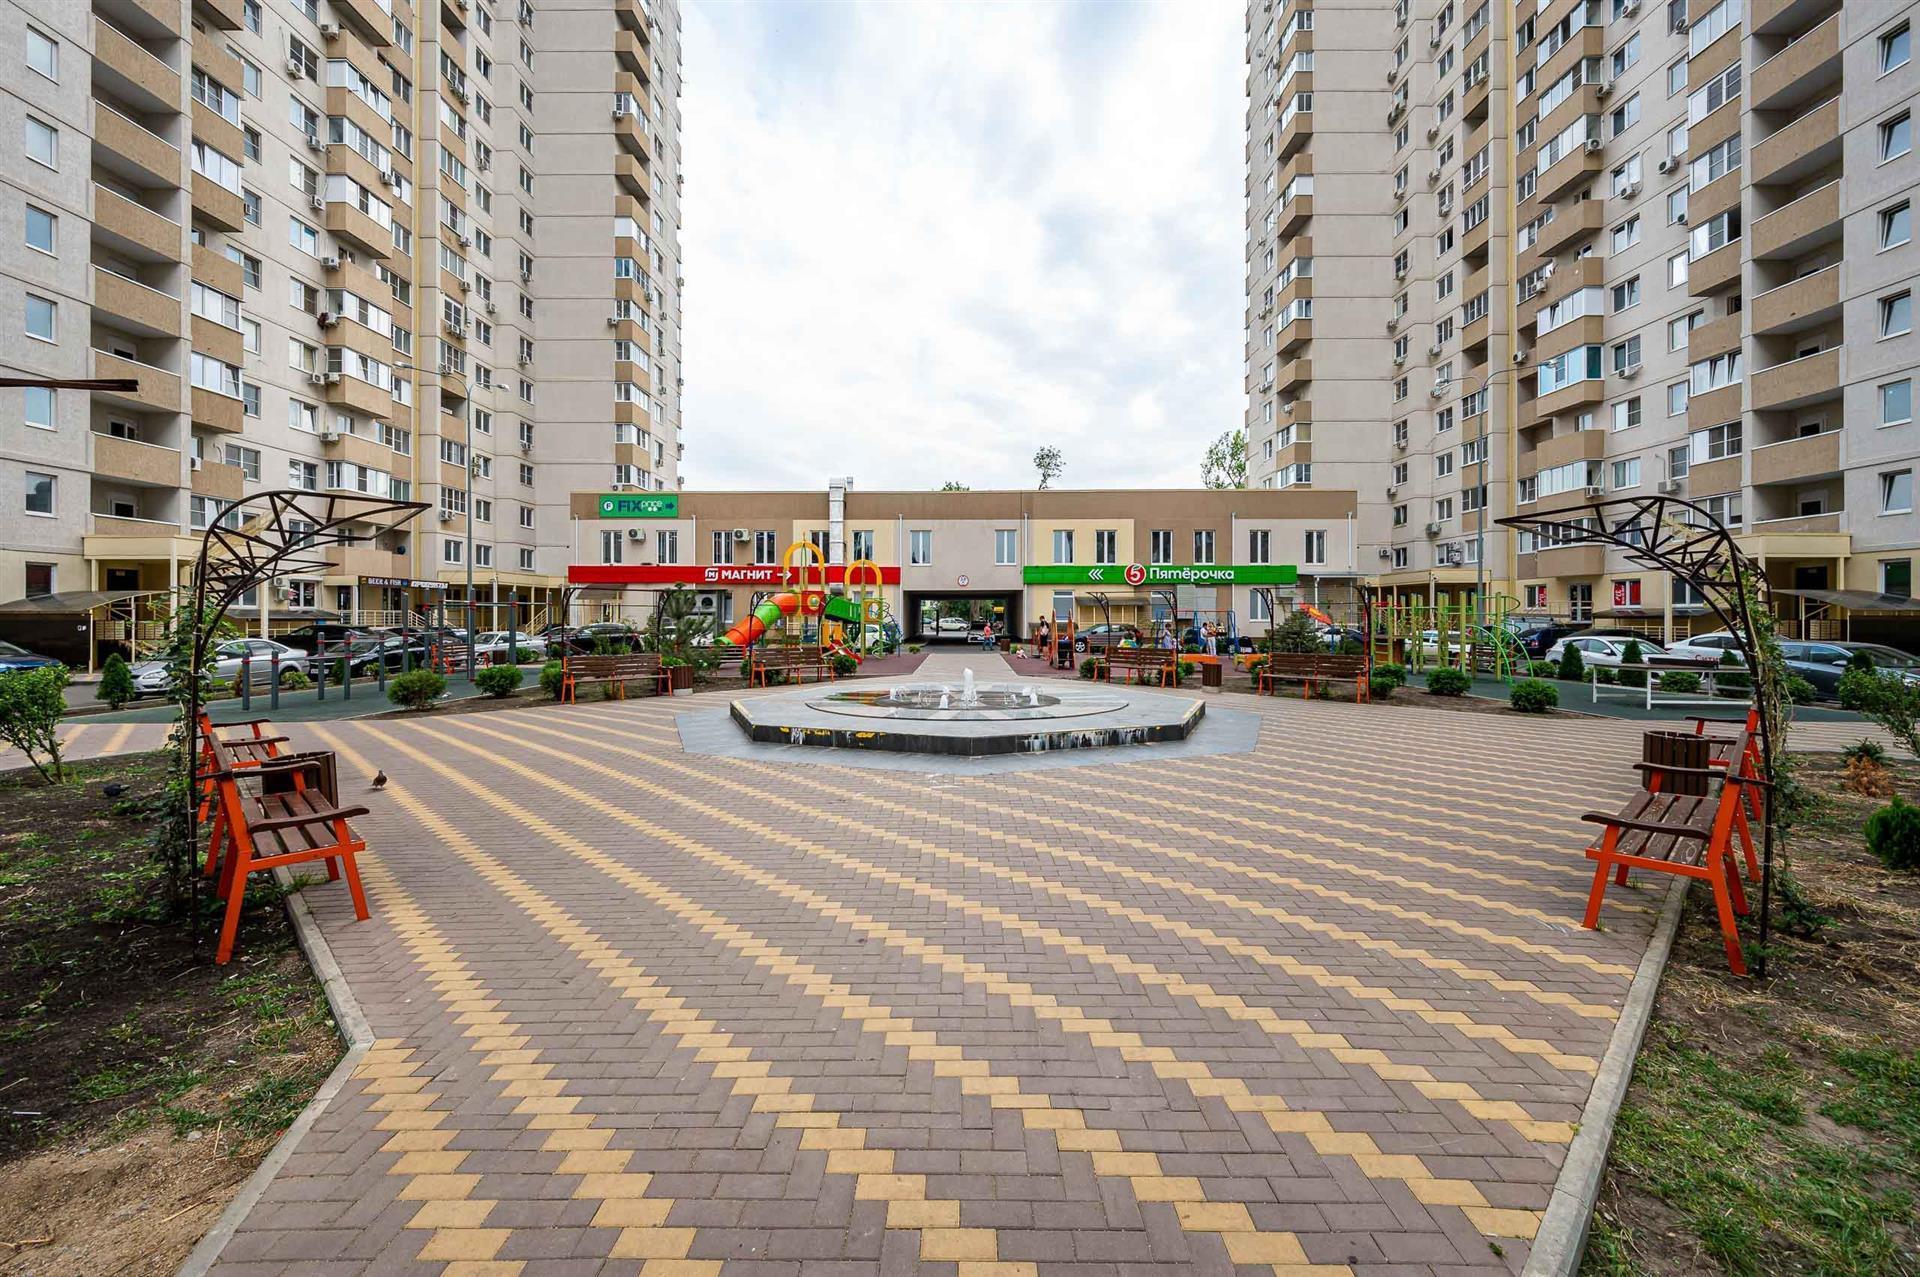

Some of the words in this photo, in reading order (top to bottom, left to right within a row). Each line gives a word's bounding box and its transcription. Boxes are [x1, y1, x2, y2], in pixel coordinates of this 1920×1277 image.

[618, 500, 642, 512] FIX
[721, 569, 773, 580] МАГНИТ
[1130, 565, 1141, 581] 5
[1149, 567, 1234, 581] Пятёрочка
